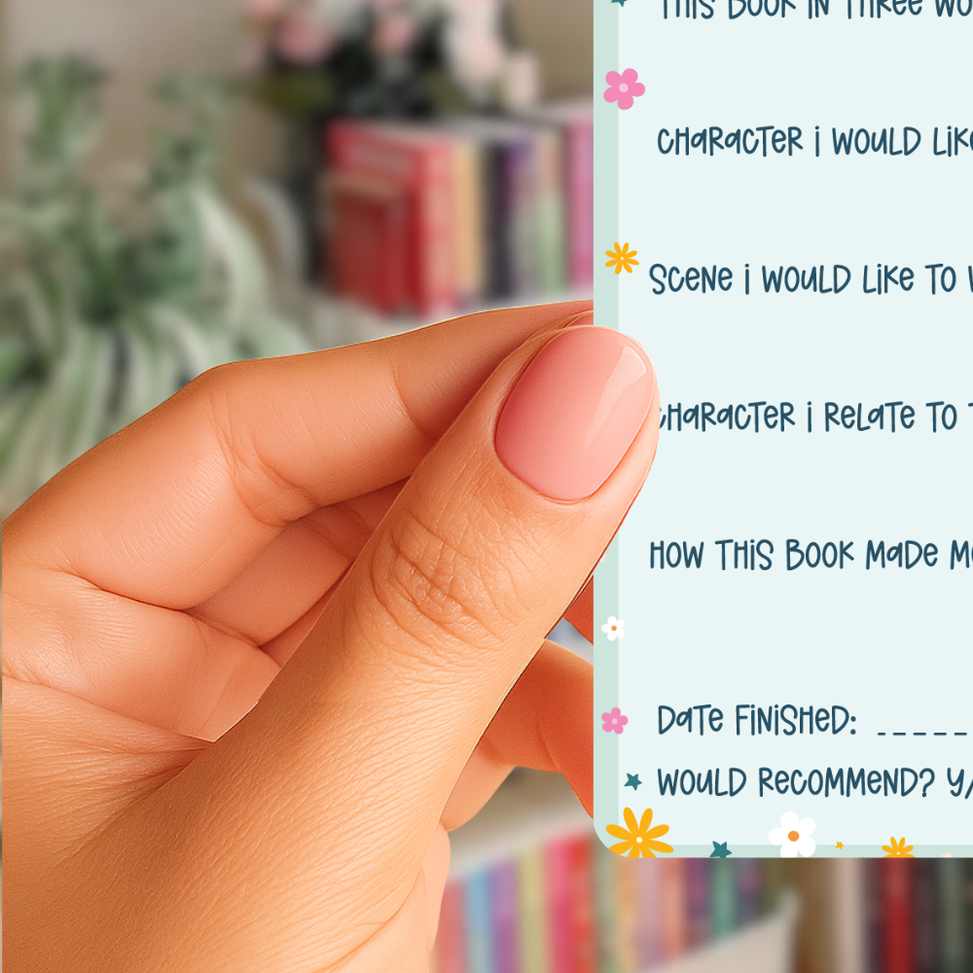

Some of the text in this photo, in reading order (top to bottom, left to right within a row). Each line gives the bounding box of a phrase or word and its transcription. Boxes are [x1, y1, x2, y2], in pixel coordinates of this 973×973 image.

[924, 263, 957, 296] TO
[925, 400, 958, 434] TO
[650, 539, 705, 570] HOW
[785, 538, 855, 571] BOOK
